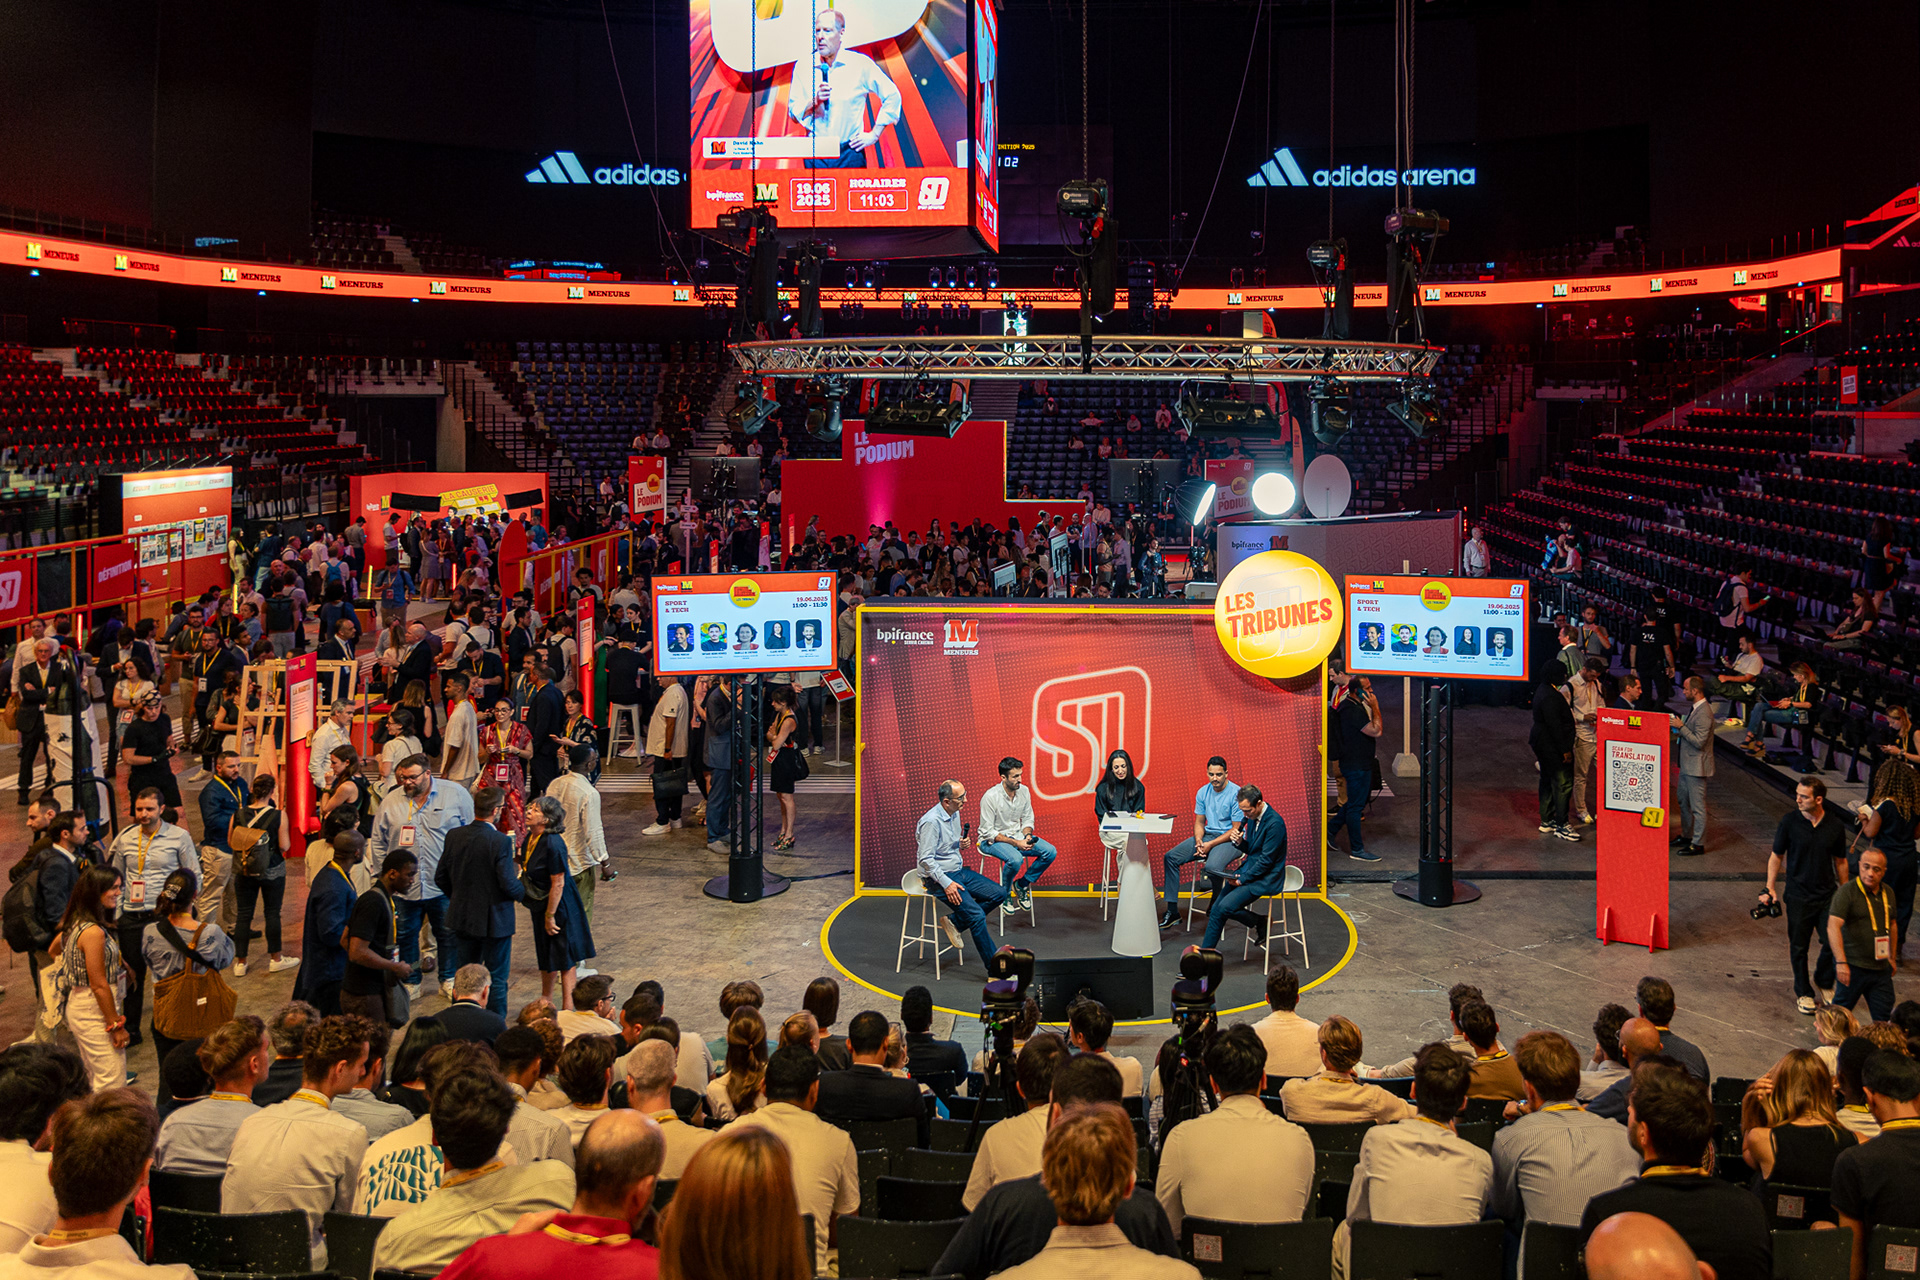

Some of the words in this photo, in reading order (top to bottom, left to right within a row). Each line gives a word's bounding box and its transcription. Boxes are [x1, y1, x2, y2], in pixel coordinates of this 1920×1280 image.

[593, 163, 680, 185] adidas
[1312, 164, 1397, 187] adidas
[1402, 168, 1476, 186] arena
[796, 183, 831, 194] 19.06
[849, 179, 906, 188] HORAIRES
[796, 195, 831, 206] 2025
[860, 194, 894, 207] 11:03
[44, 250, 80, 262] MENEURS
[130, 261, 160, 272] MENEURS
[241, 272, 281, 283] MENEURS
[1665, 278, 1698, 288] MENEURS
[339, 279, 384, 289] MENEURS
[450, 285, 492, 294] MENEURS
[1571, 284, 1612, 294] MENEURS
[587, 289, 631, 298] MENEURS
[1246, 294, 1284, 302] MENEURS
[1445, 290, 1486, 298] MENEURS
[854, 432, 870, 446] LE
[855, 440, 914, 466] PODIUM
[442, 492, 455, 500] LA
[456, 485, 496, 498] CAUSERIE
[637, 488, 644, 496] LE
[1218, 492, 1226, 500] LE
[638, 494, 662, 508] PODIUM
[1218, 497, 1250, 511] PODIUM
[1232, 540, 1264, 550] bpifrance
[1225, 592, 1255, 613] LES
[1226, 598, 1333, 639] TRIBUNES
[876, 627, 934, 643] bpifrance
[1612, 751, 1656, 762] TRANSLATION
